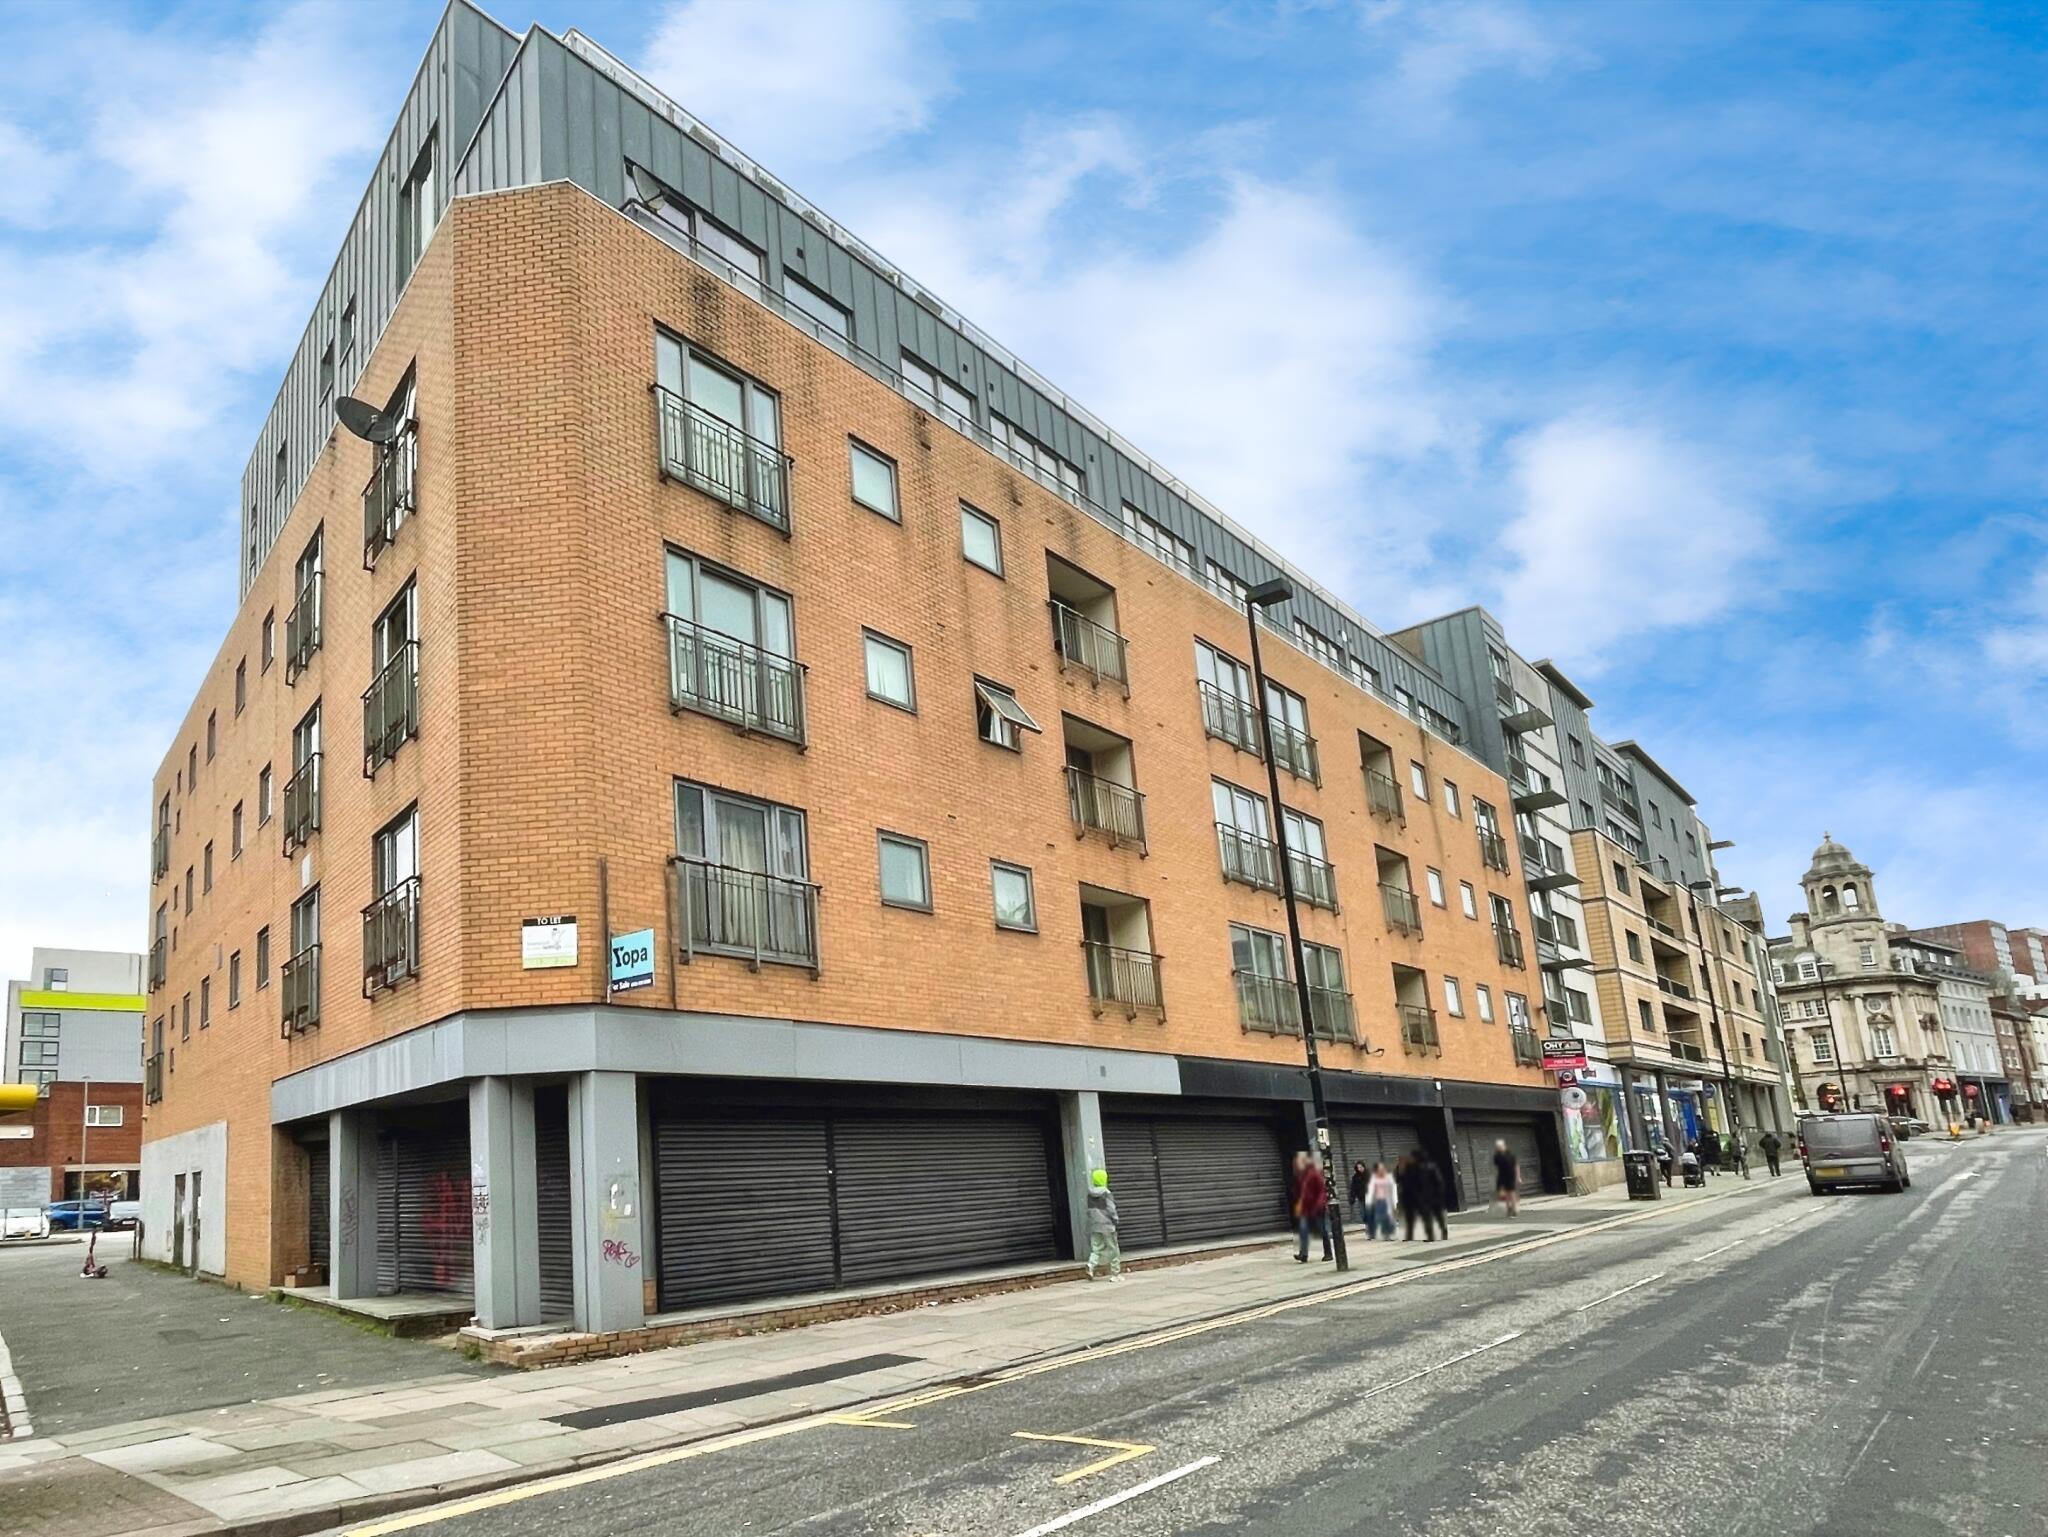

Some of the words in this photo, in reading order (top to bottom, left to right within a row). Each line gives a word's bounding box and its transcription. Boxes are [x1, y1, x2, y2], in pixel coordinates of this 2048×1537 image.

[537, 916, 549, 925] TO
[549, 916, 562, 925] LET
[612, 946, 648, 968] Yopa
